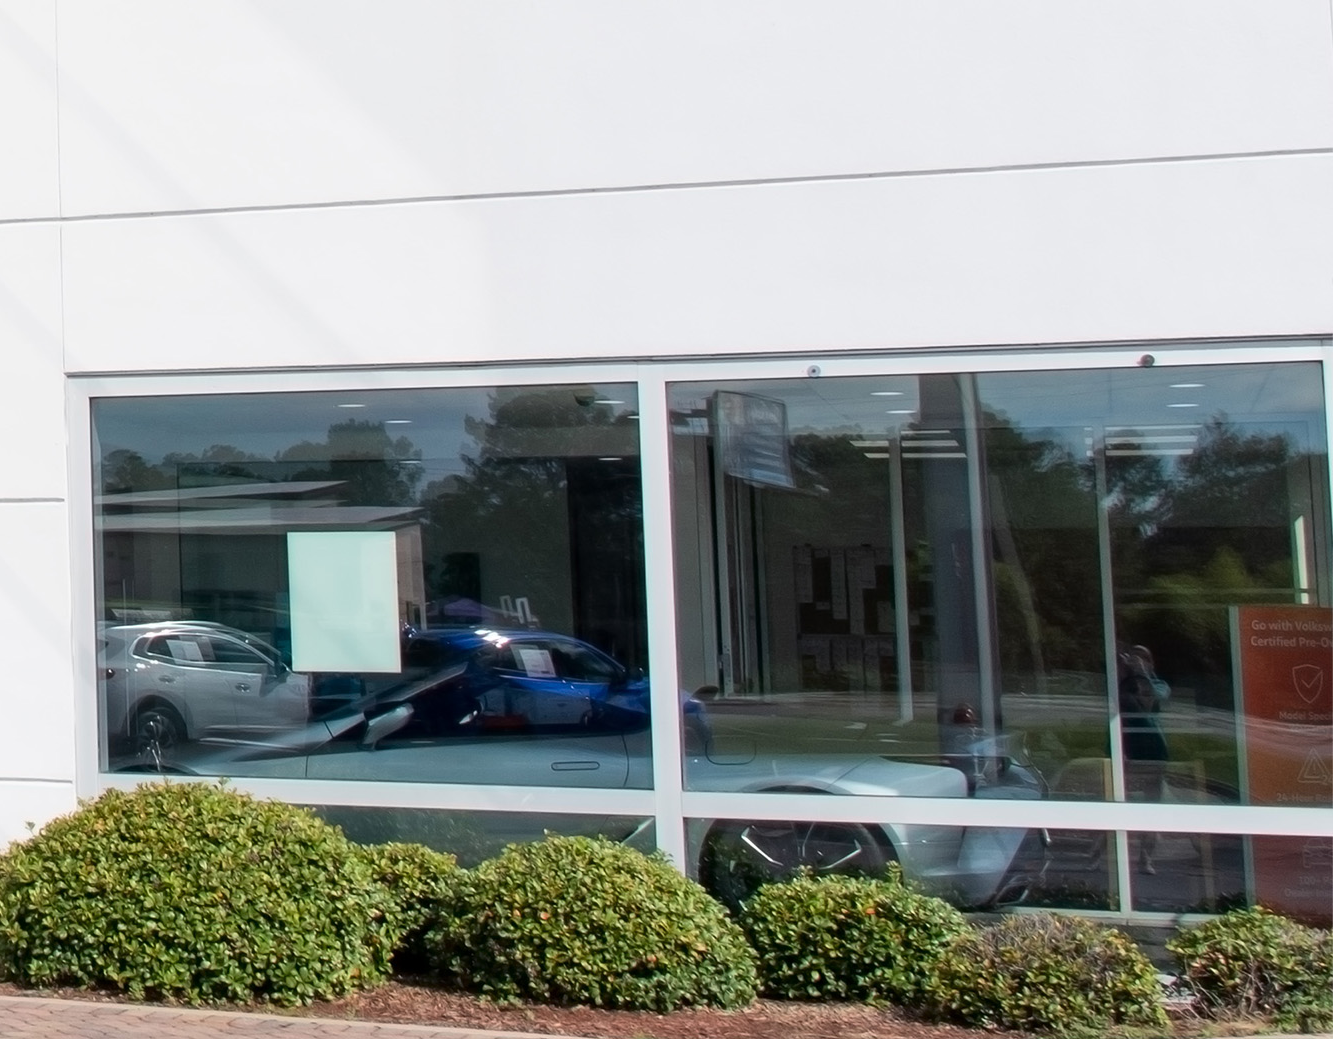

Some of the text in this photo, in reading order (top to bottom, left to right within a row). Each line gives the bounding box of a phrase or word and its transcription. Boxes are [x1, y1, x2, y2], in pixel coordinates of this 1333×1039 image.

[1251, 619, 1266, 631] Go
[1268, 620, 1292, 631] with
[1250, 635, 1296, 647] Certified
